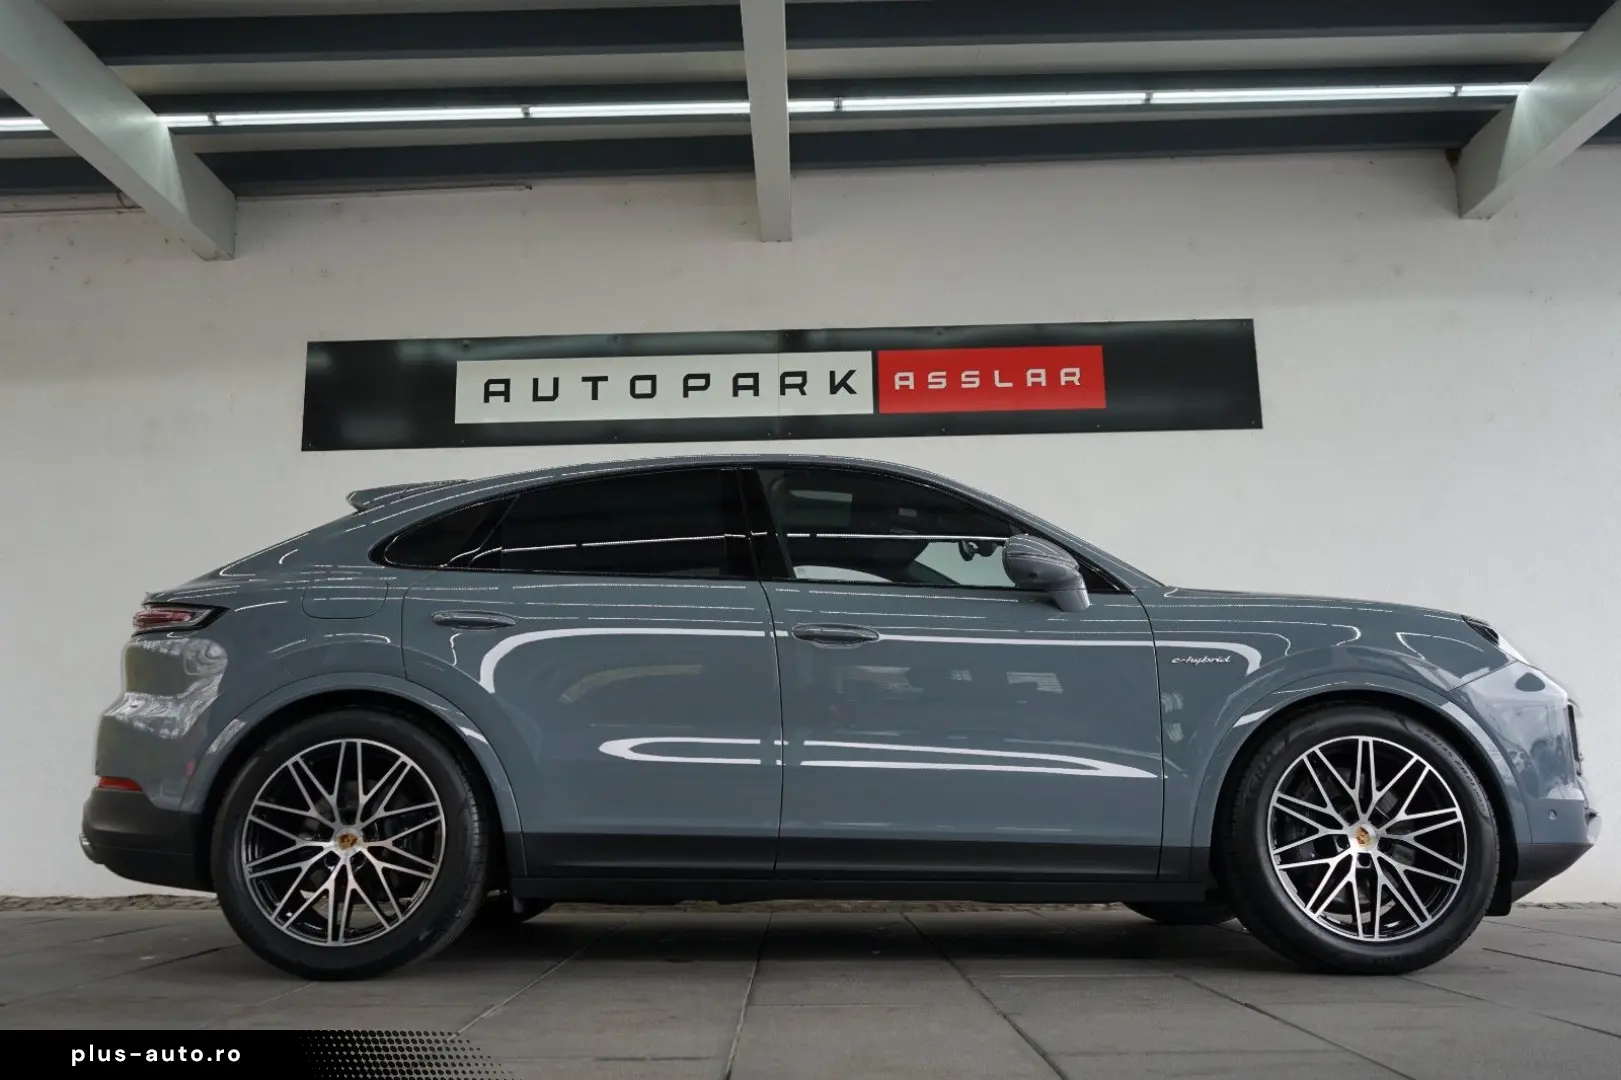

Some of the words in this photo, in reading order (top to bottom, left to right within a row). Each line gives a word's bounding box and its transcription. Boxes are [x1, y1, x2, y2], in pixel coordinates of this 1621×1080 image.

[483, 369, 858, 404] AUTOPARK
[894, 367, 1081, 390] ASSLAR
[1171, 655, 1231, 665] e-hybrid
